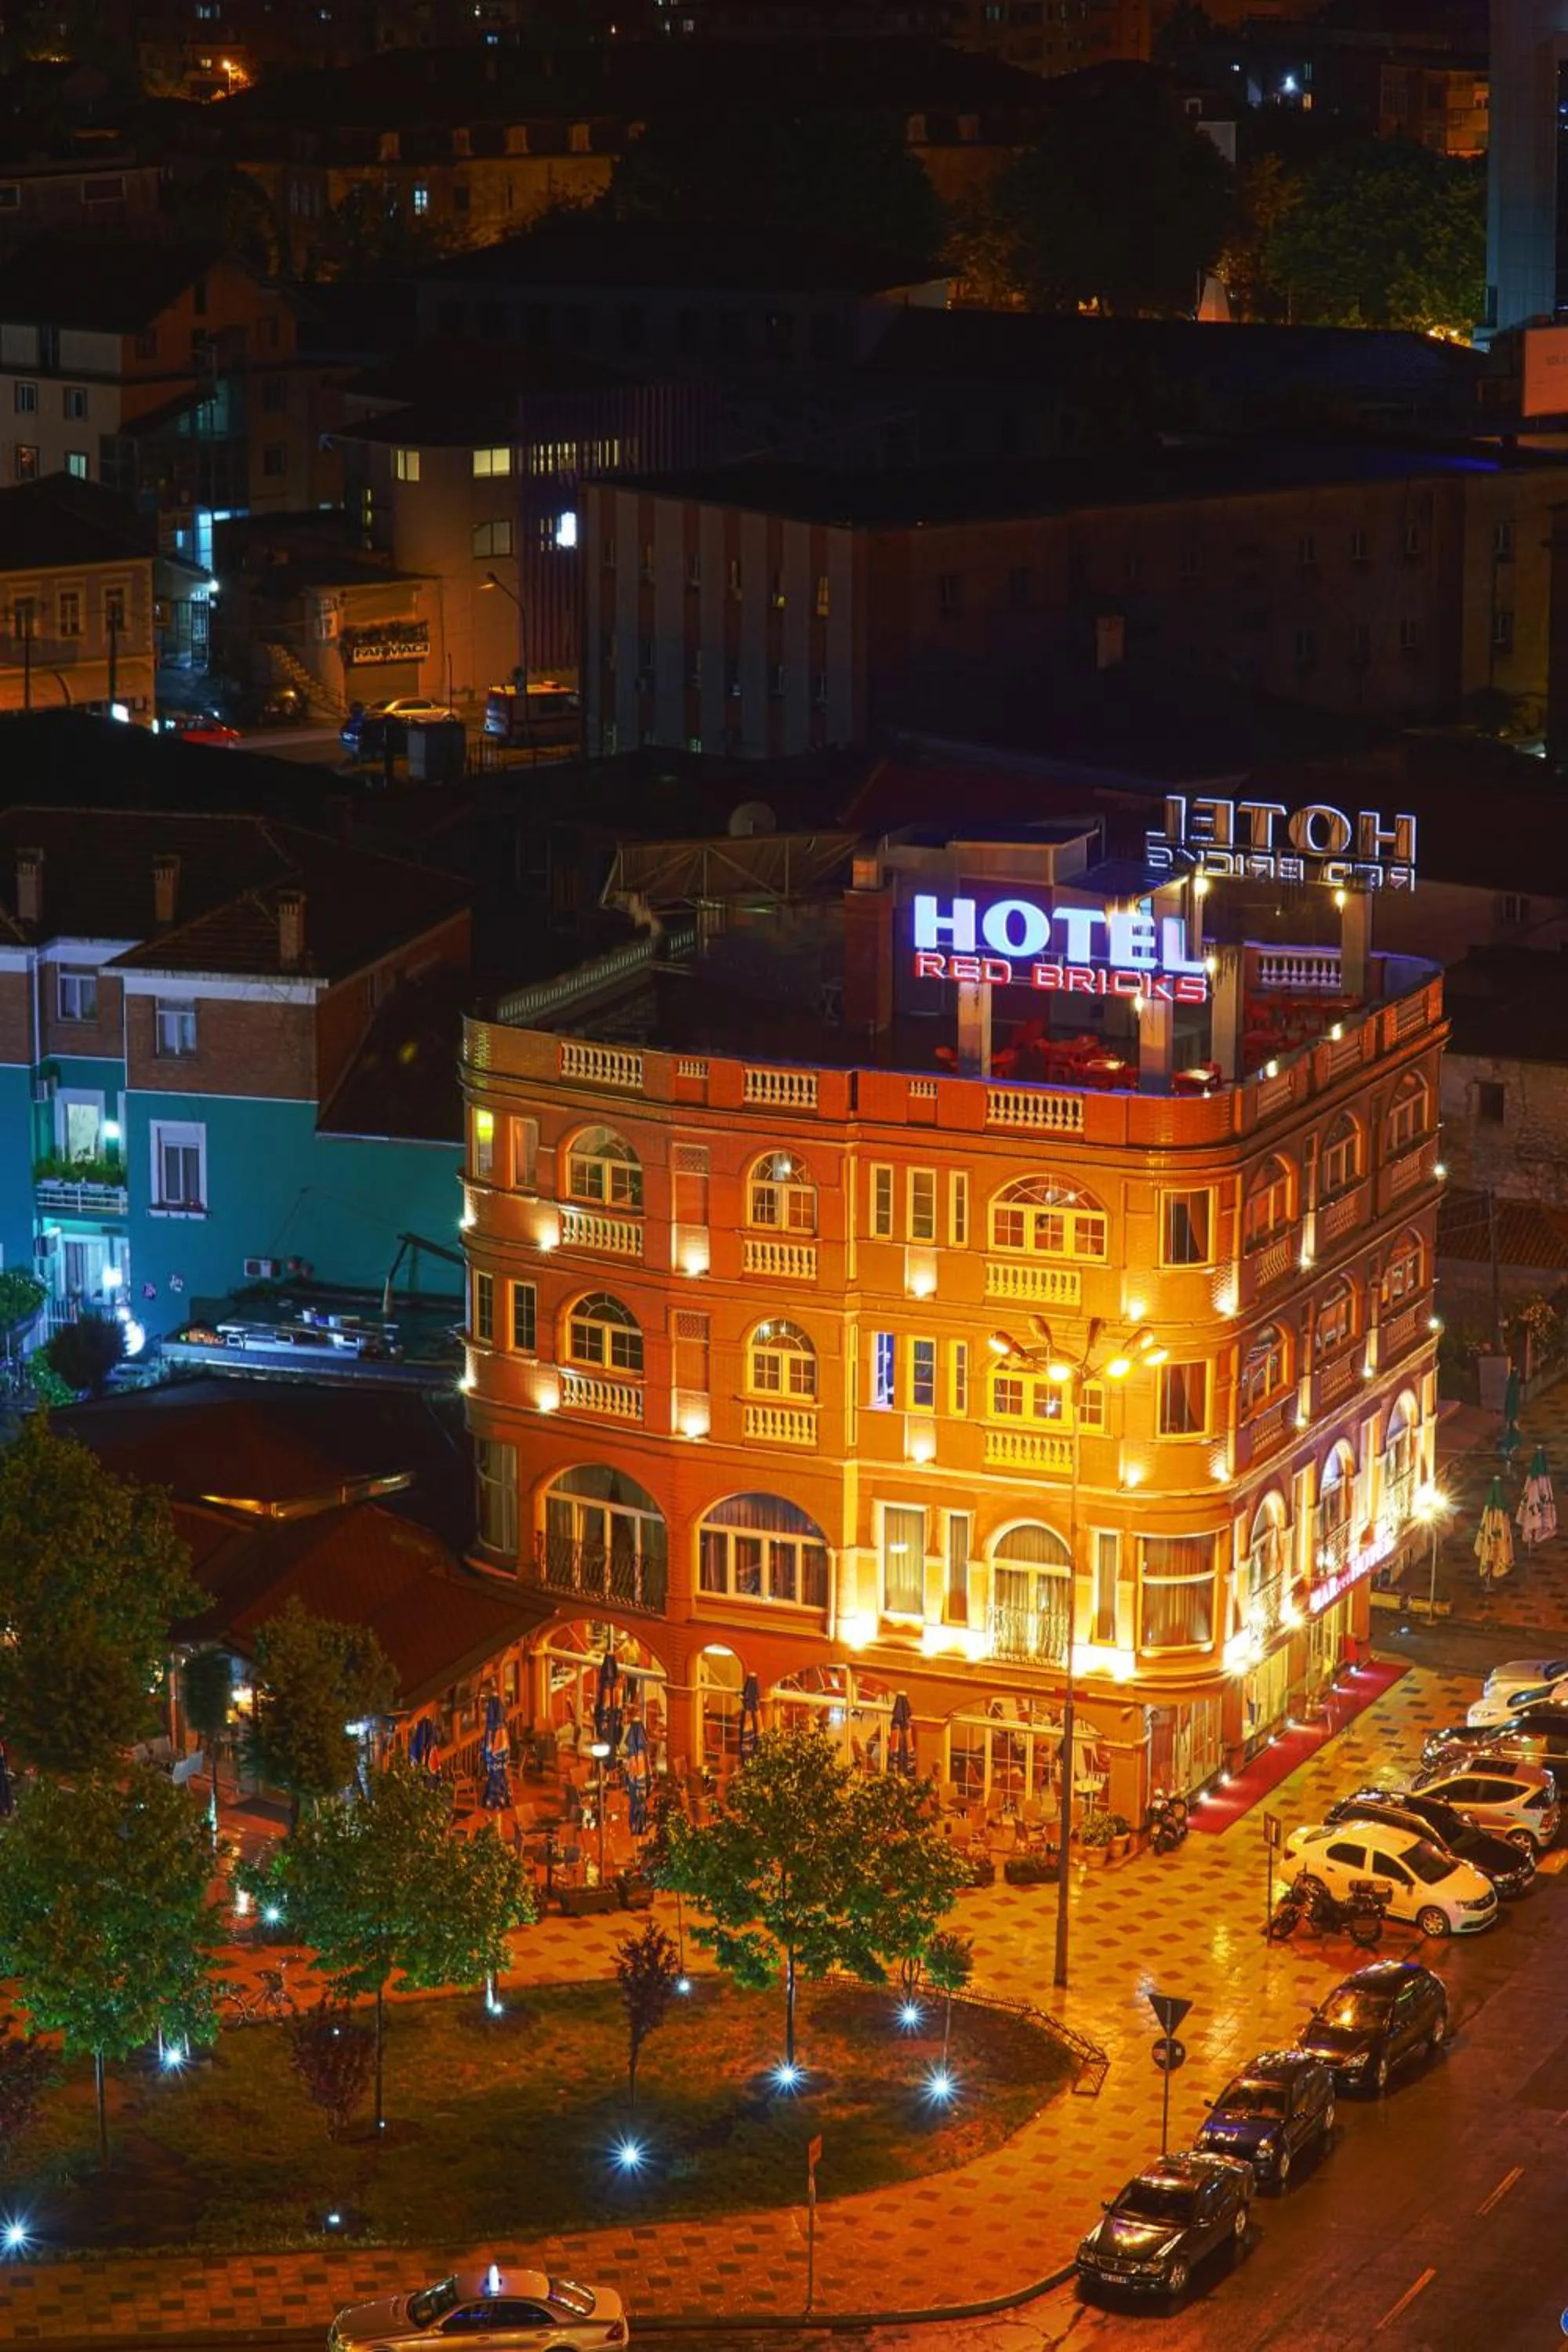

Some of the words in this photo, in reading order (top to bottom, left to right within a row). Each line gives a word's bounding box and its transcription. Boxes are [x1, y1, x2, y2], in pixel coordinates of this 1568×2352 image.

[913, 895, 1205, 974] HOTEL
[914, 952, 1013, 986] RED
[1030, 962, 1208, 1005] BRICKS
